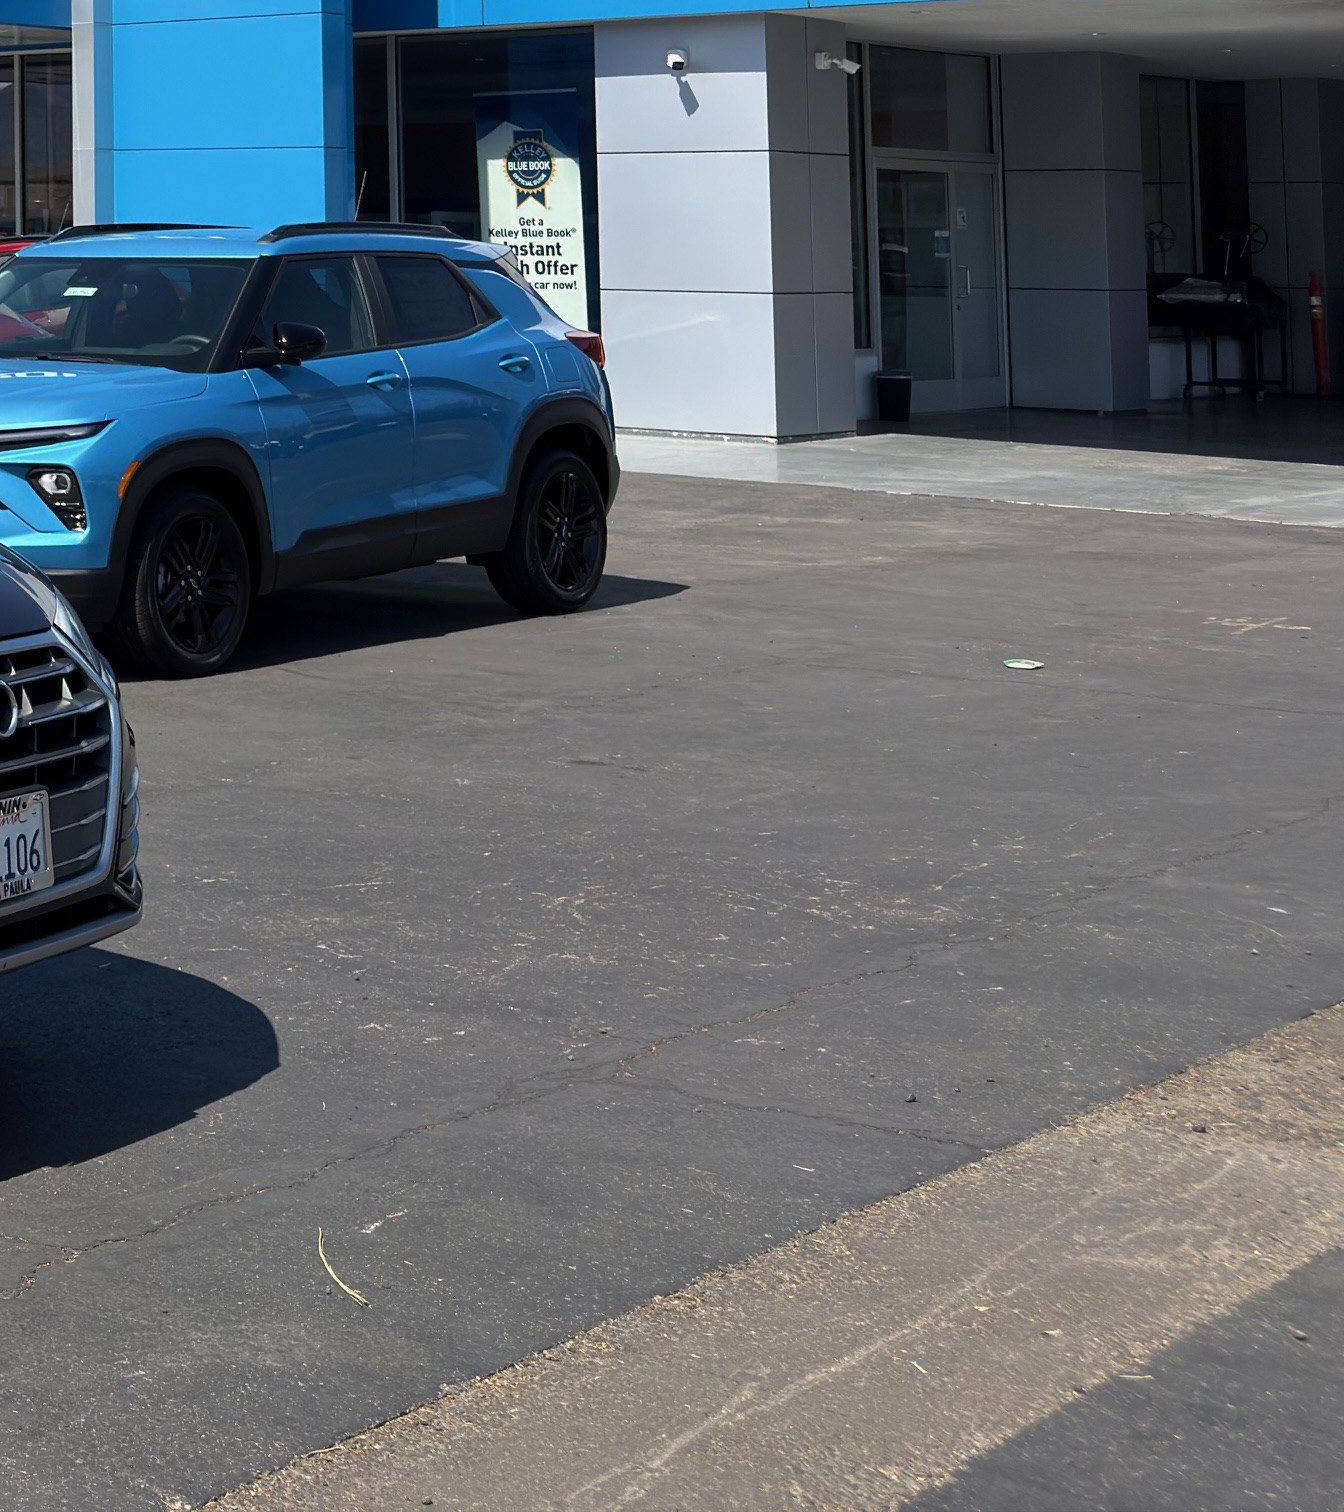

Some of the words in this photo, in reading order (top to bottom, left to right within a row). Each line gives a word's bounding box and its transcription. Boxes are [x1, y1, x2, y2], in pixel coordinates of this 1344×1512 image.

[512, 144, 548, 159] KELLEY
[508, 161, 528, 171] BLUE
[529, 160, 551, 170] BOOK
[518, 217, 535, 226] Get
[537, 218, 544, 226] a
[488, 228, 519, 239] Kelley
[521, 228, 544, 238] Blue
[504, 241, 562, 256] nstant
[534, 260, 578, 276] Offer
[534, 281, 550, 289] car
[552, 280, 577, 290] now!
[3, 877, 32, 899] PAULA
